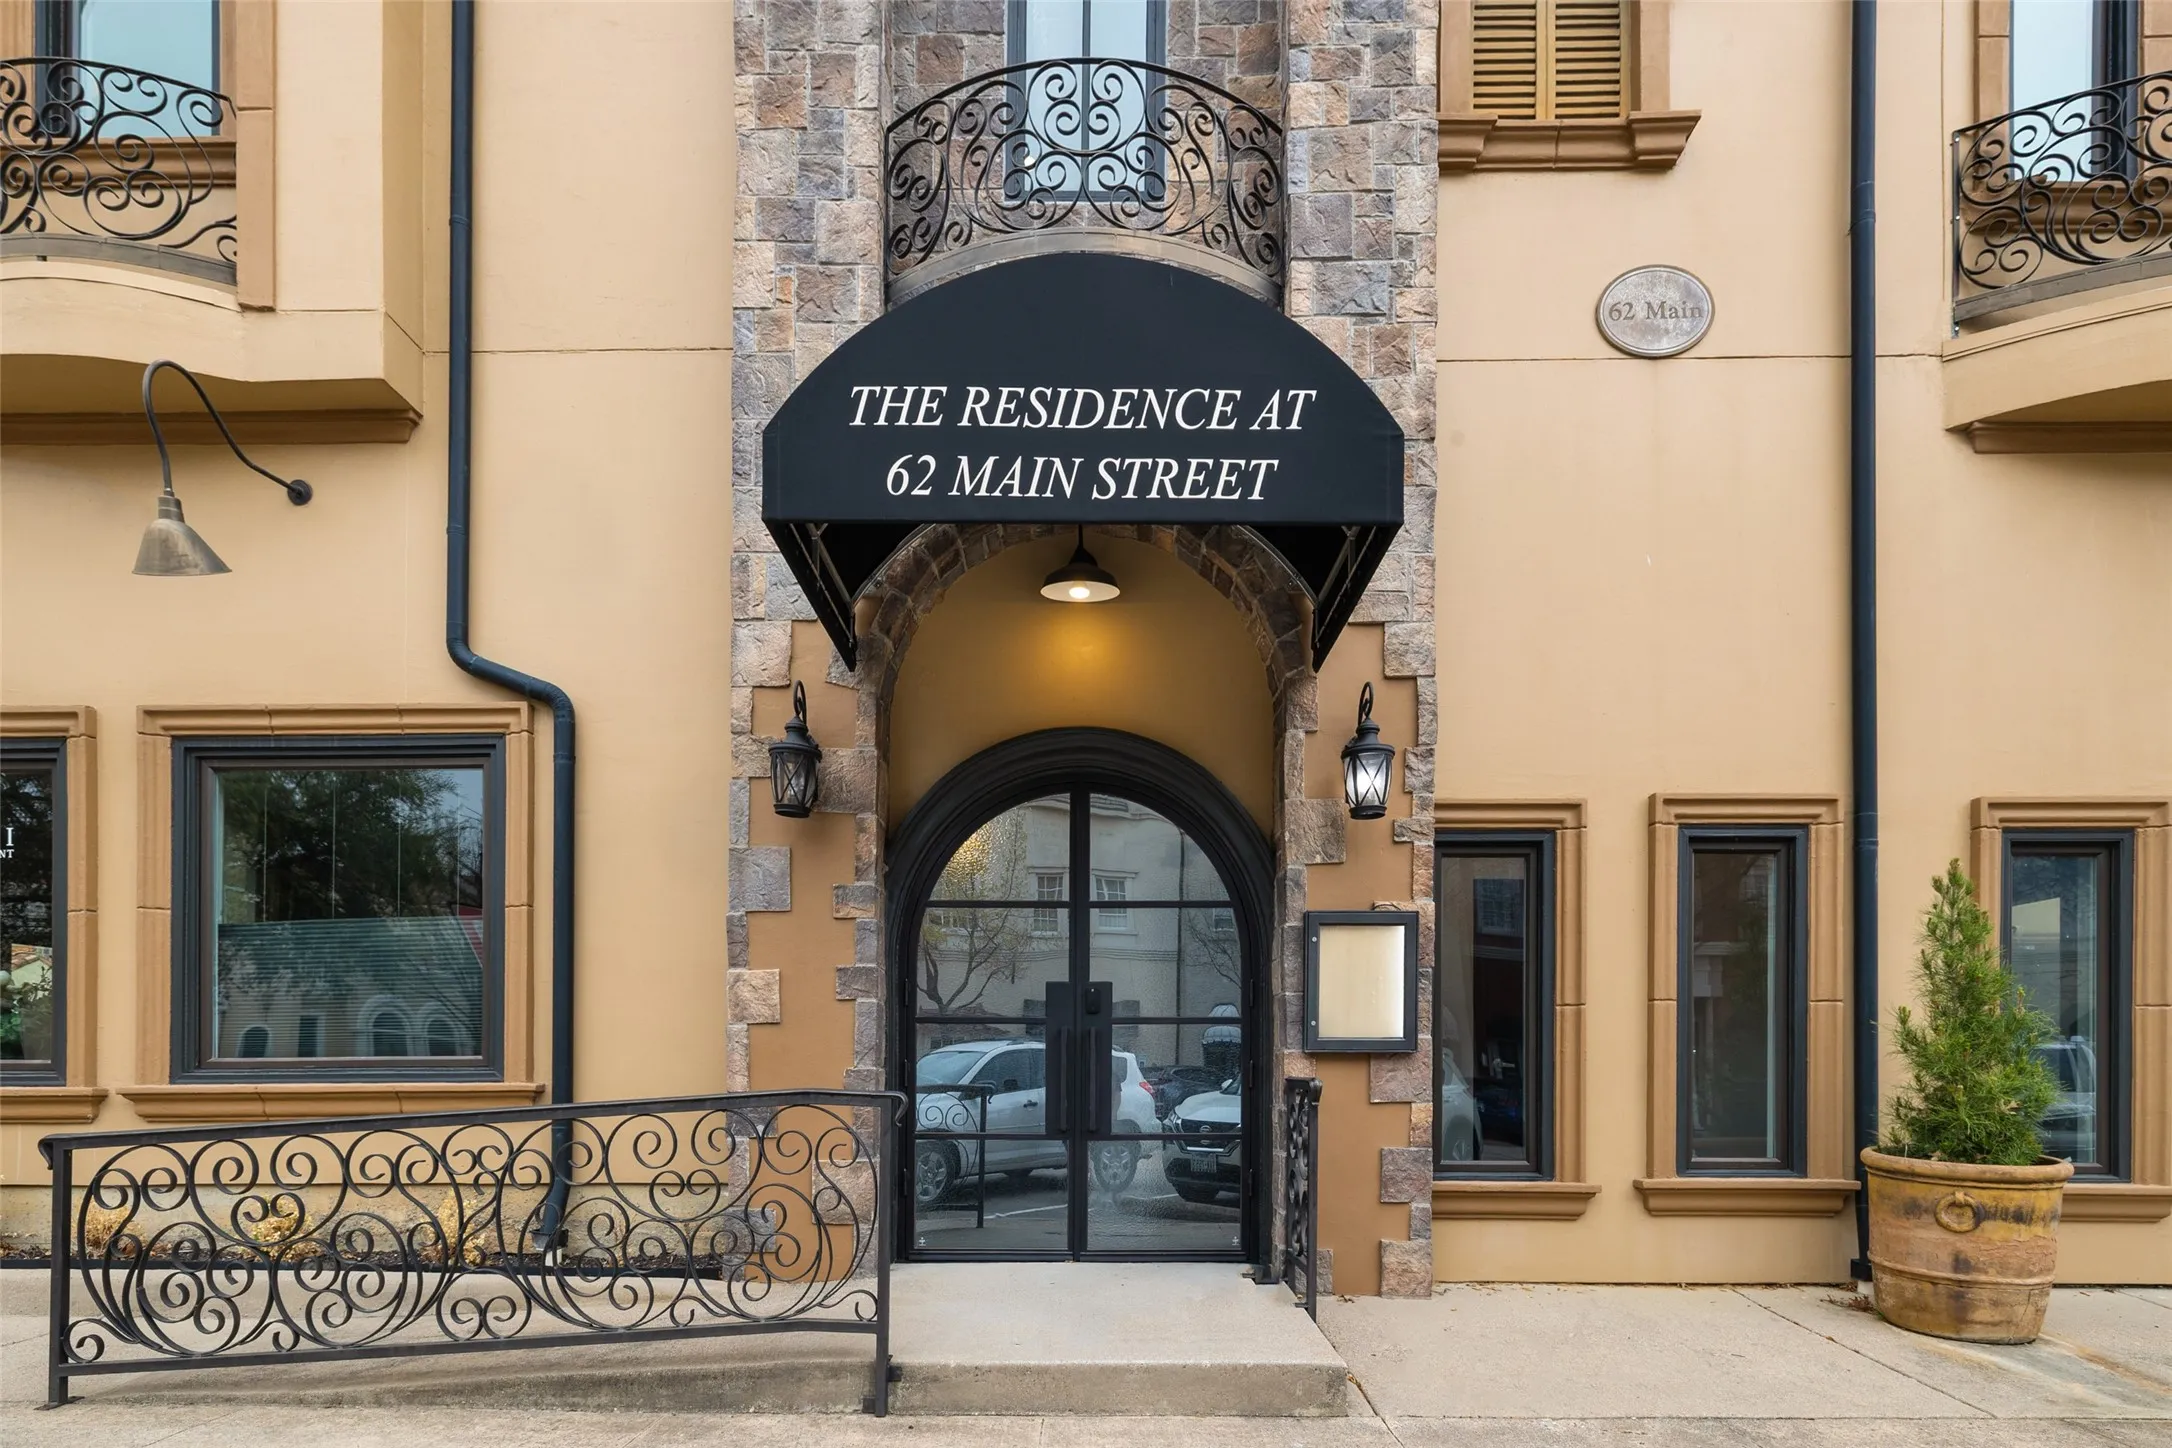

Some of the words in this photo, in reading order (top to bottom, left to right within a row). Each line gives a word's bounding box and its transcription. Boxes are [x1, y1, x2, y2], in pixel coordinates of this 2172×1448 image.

[1608, 302, 1636, 321] 62
[1645, 301, 1704, 320] Main
[848, 385, 948, 427] THE
[956, 386, 1242, 430] RESIDENCE
[1248, 388, 1318, 431] AT
[886, 454, 937, 497] 62
[947, 455, 1085, 499] MAIN
[1091, 457, 1281, 501] STREET
